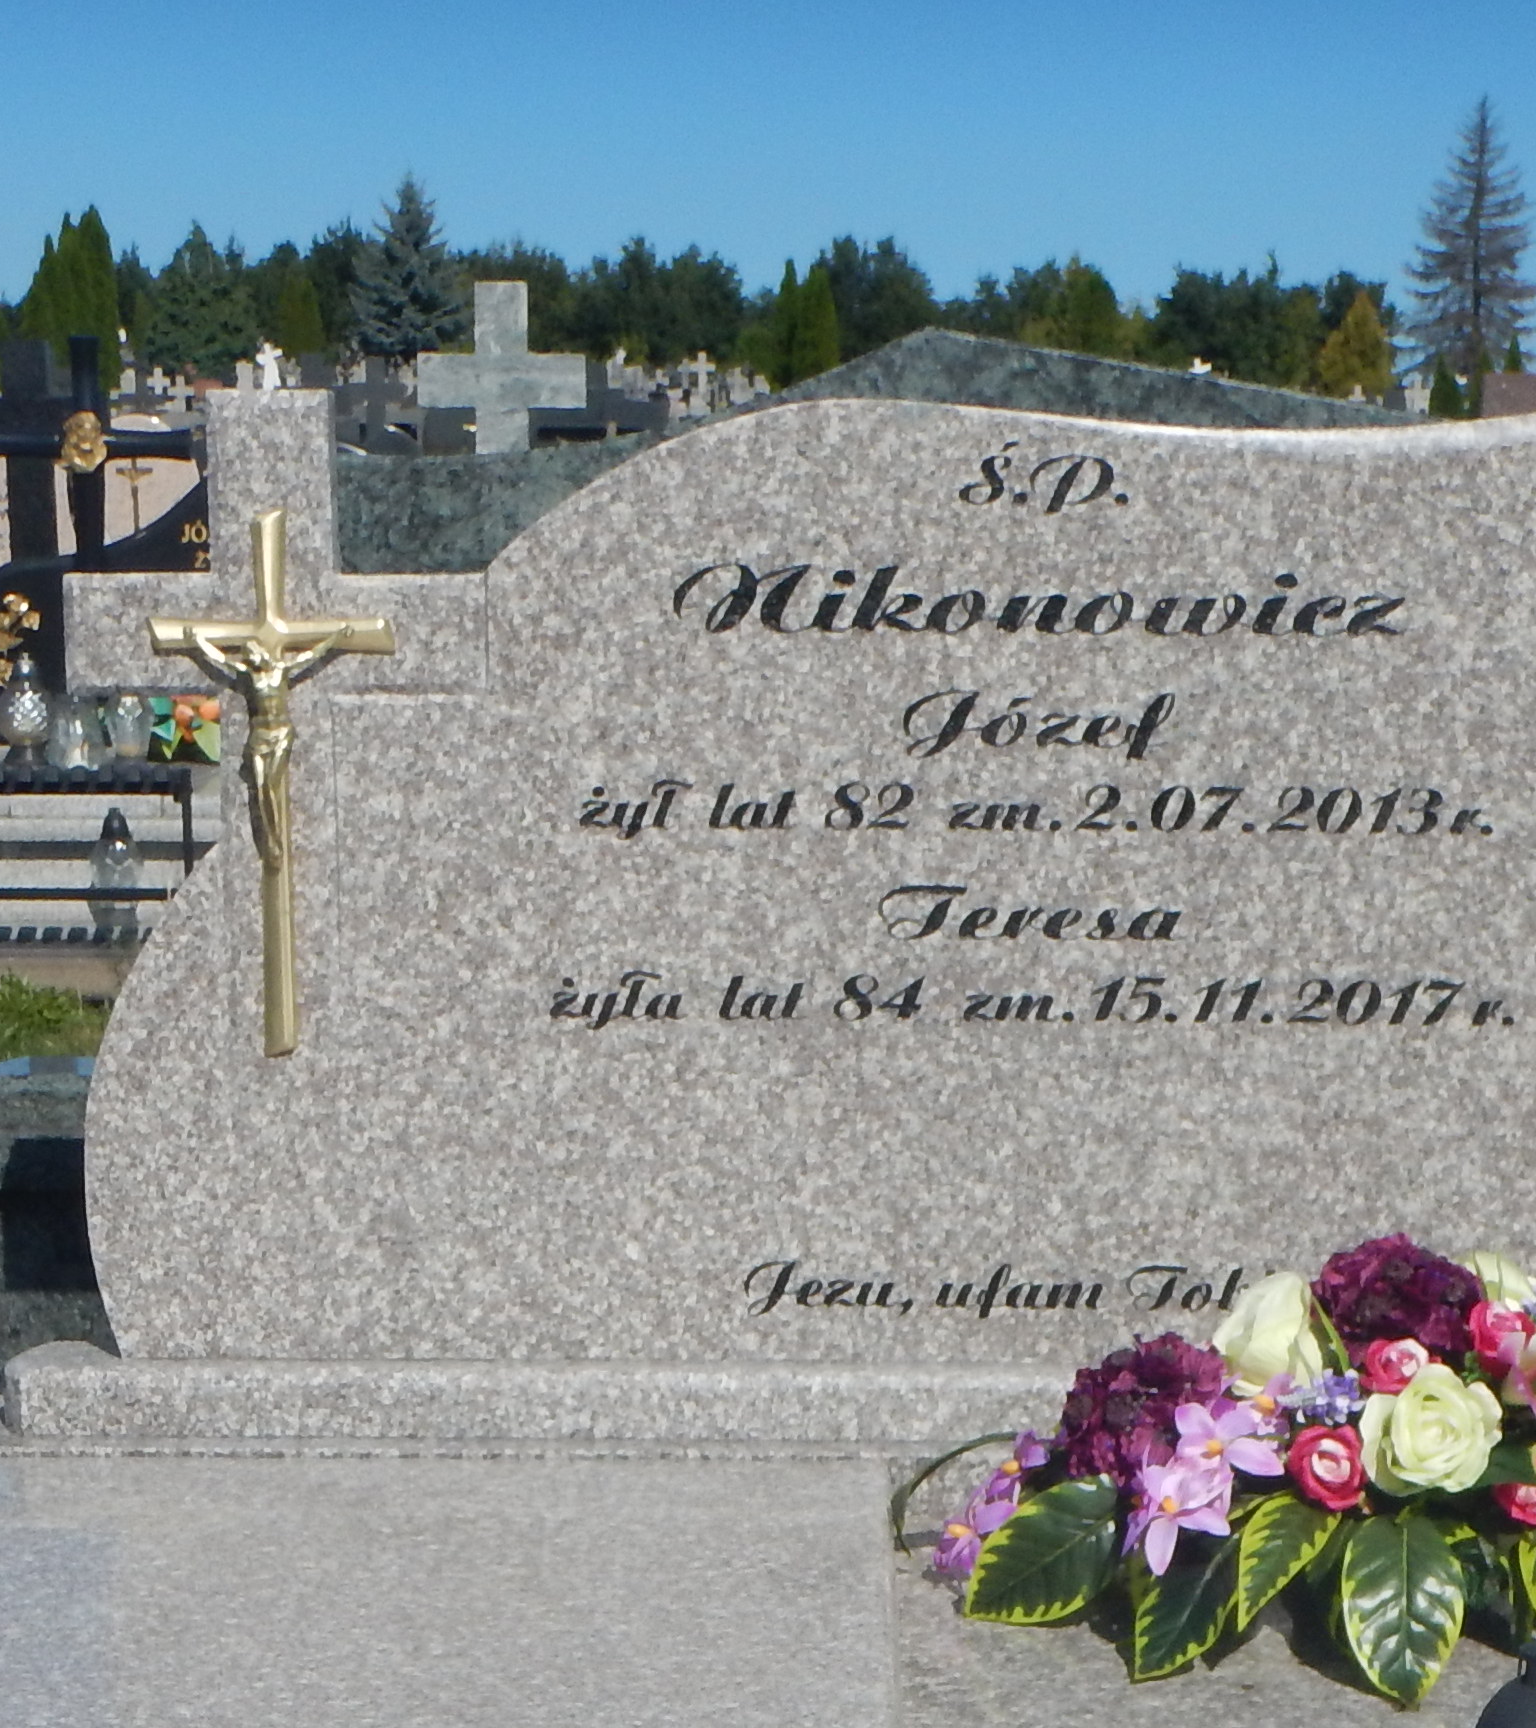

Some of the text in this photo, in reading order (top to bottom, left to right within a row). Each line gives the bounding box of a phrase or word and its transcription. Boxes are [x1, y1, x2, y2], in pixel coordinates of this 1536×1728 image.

[959, 441, 1130, 514] Ś.P.
[181, 519, 208, 544] JÓ
[672, 562, 1408, 638] Nikonowicz
[901, 687, 1177, 760] Józef
[578, 778, 693, 840] żył
[708, 783, 797, 830] lat
[824, 780, 915, 831] 82
[876, 884, 1183, 941] Teresa
[548, 970, 690, 1031] żyła
[717, 975, 805, 1021] lat
[832, 974, 928, 1022] 84
[743, 1259, 915, 1317] Jezu,
[935, 1263, 1105, 1319] ufam
